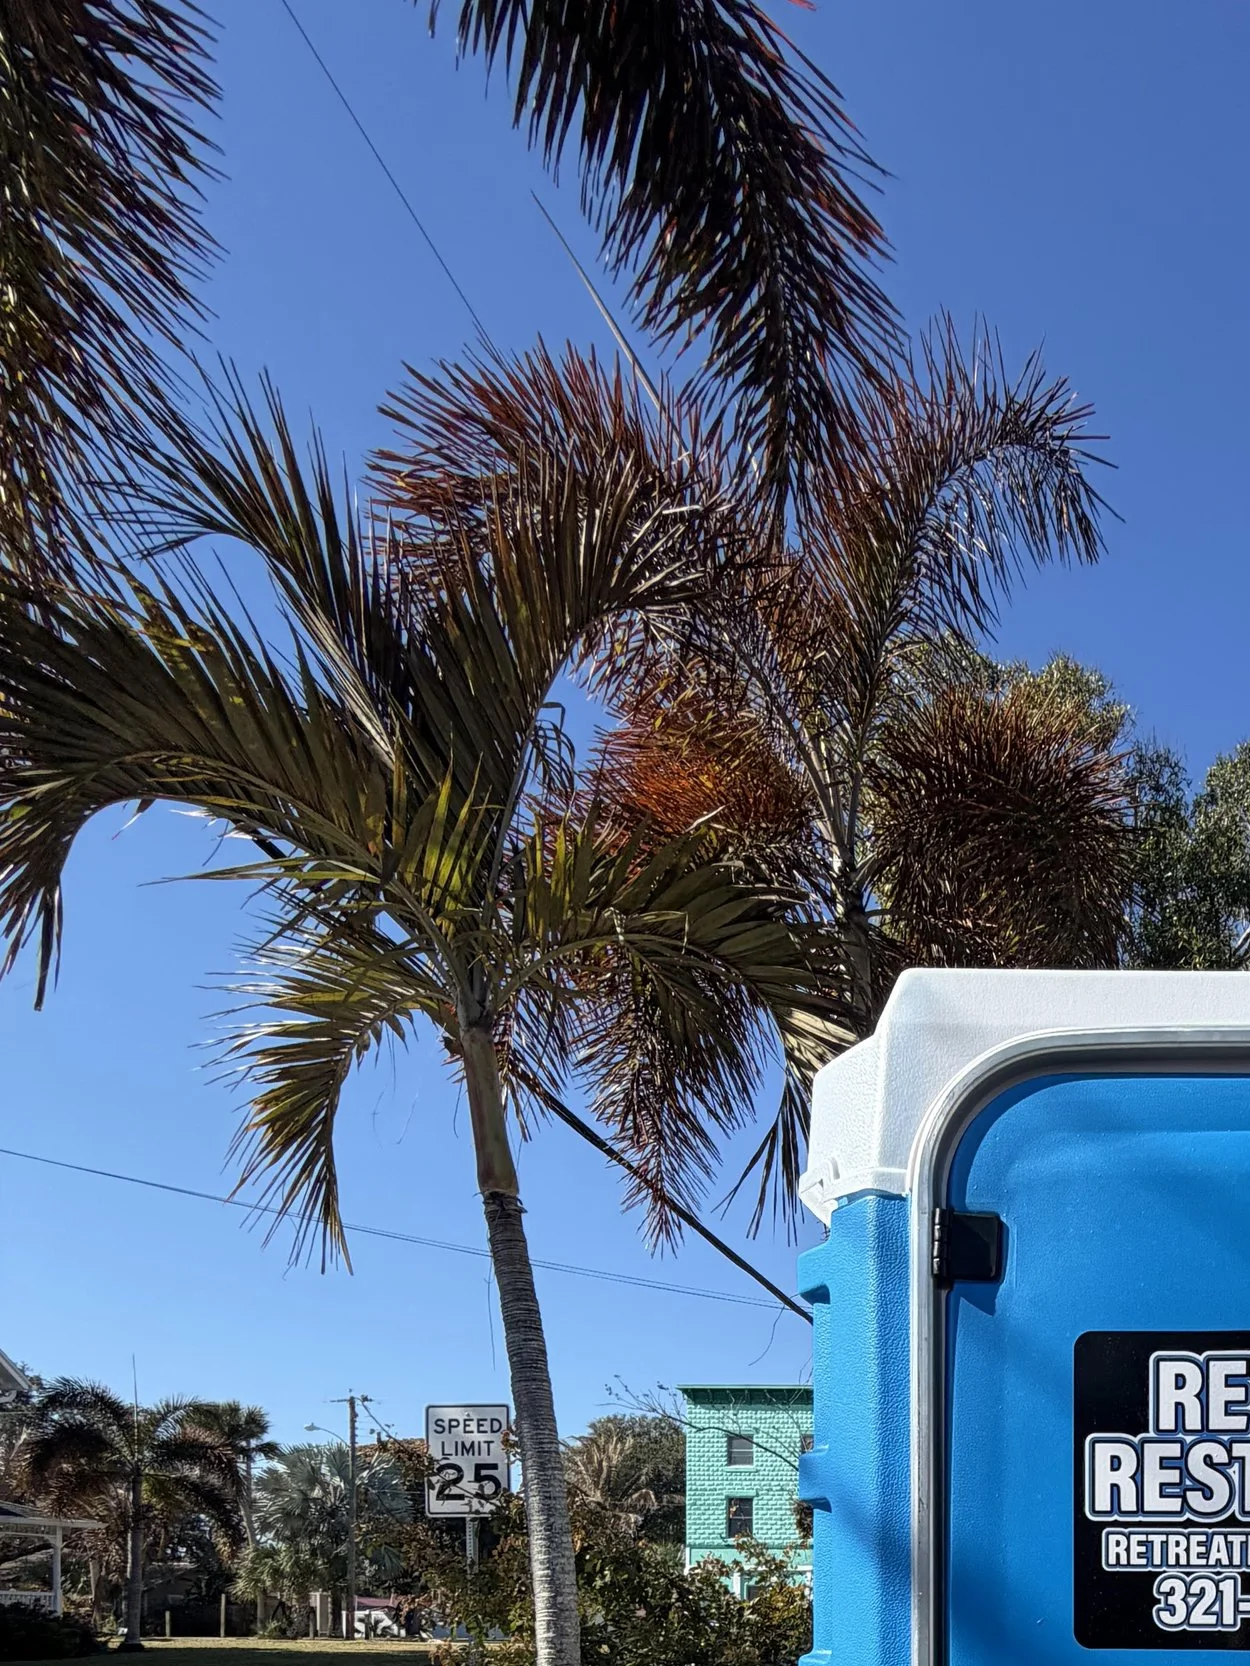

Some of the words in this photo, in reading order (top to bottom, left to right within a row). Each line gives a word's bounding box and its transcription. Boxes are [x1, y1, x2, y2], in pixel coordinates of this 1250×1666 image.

[433, 1418, 503, 1434] SPEED
[441, 1441, 495, 1457] LIMIT
[435, 1462, 503, 1501] 25
